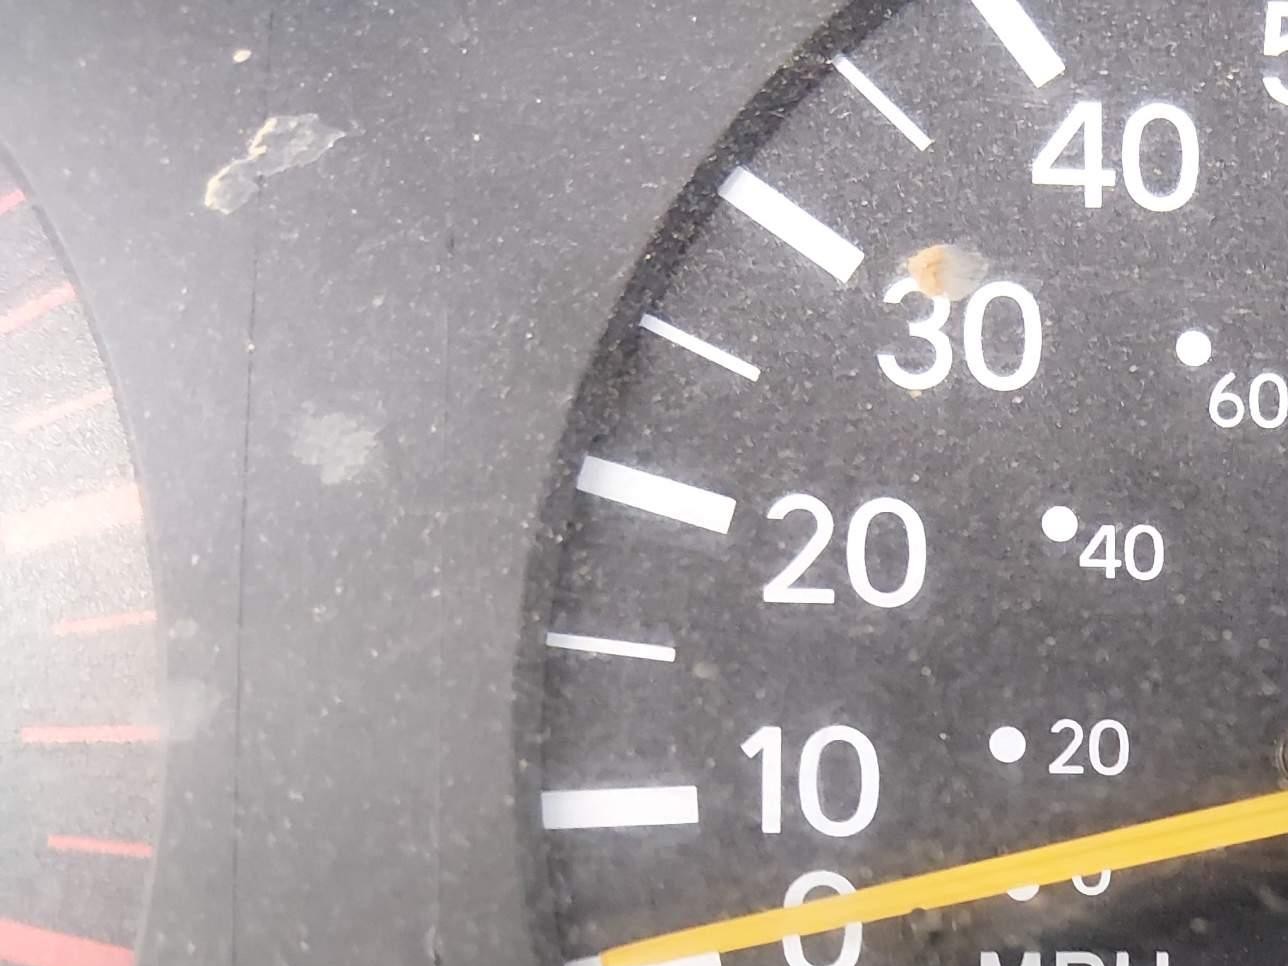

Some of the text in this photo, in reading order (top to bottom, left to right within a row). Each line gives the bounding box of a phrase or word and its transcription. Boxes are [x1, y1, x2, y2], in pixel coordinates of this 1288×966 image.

[1029, 100, 1199, 212] 40
[877, 270, 1042, 391] 30
[1209, 372, 1288, 428] 60
[763, 492, 926, 608] 20
[1080, 525, 1164, 580] 40
[741, 725, 879, 837] 10
[1049, 719, 1129, 775] 20
